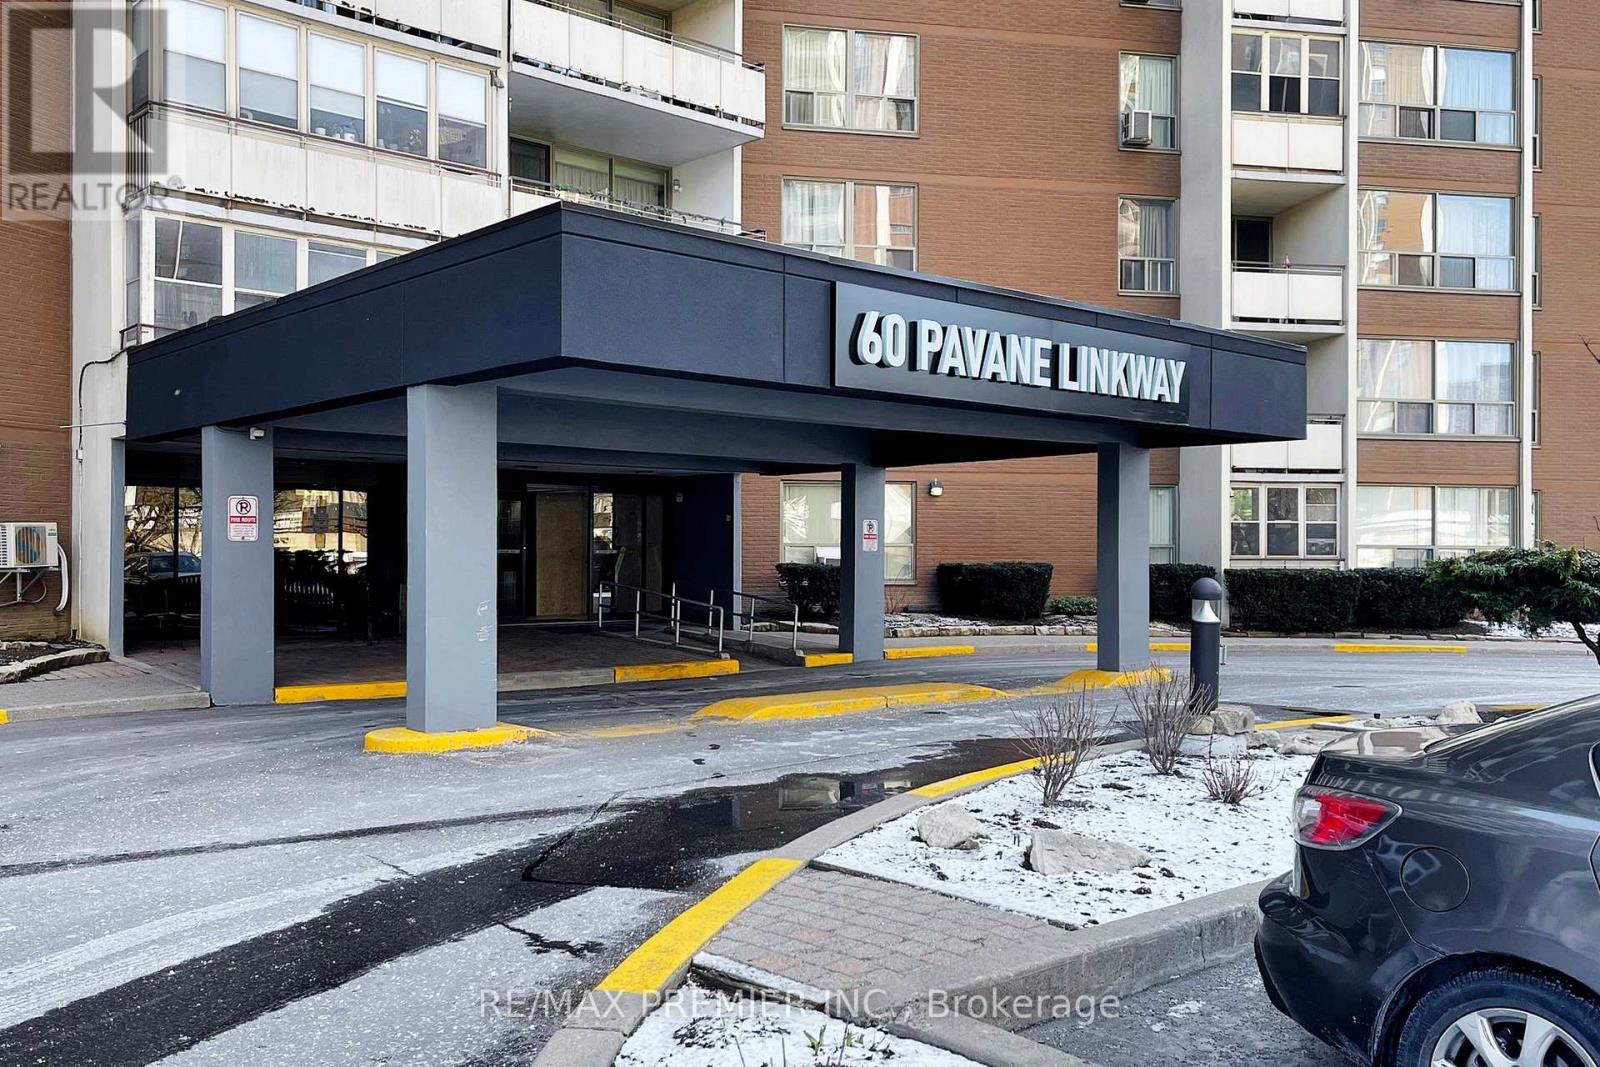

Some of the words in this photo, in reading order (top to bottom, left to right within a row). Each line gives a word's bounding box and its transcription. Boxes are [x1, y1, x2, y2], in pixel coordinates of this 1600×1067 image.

[851, 310, 907, 368] 60
[911, 318, 1052, 387] PAVANE
[1056, 342, 1186, 404] LINKWAY
